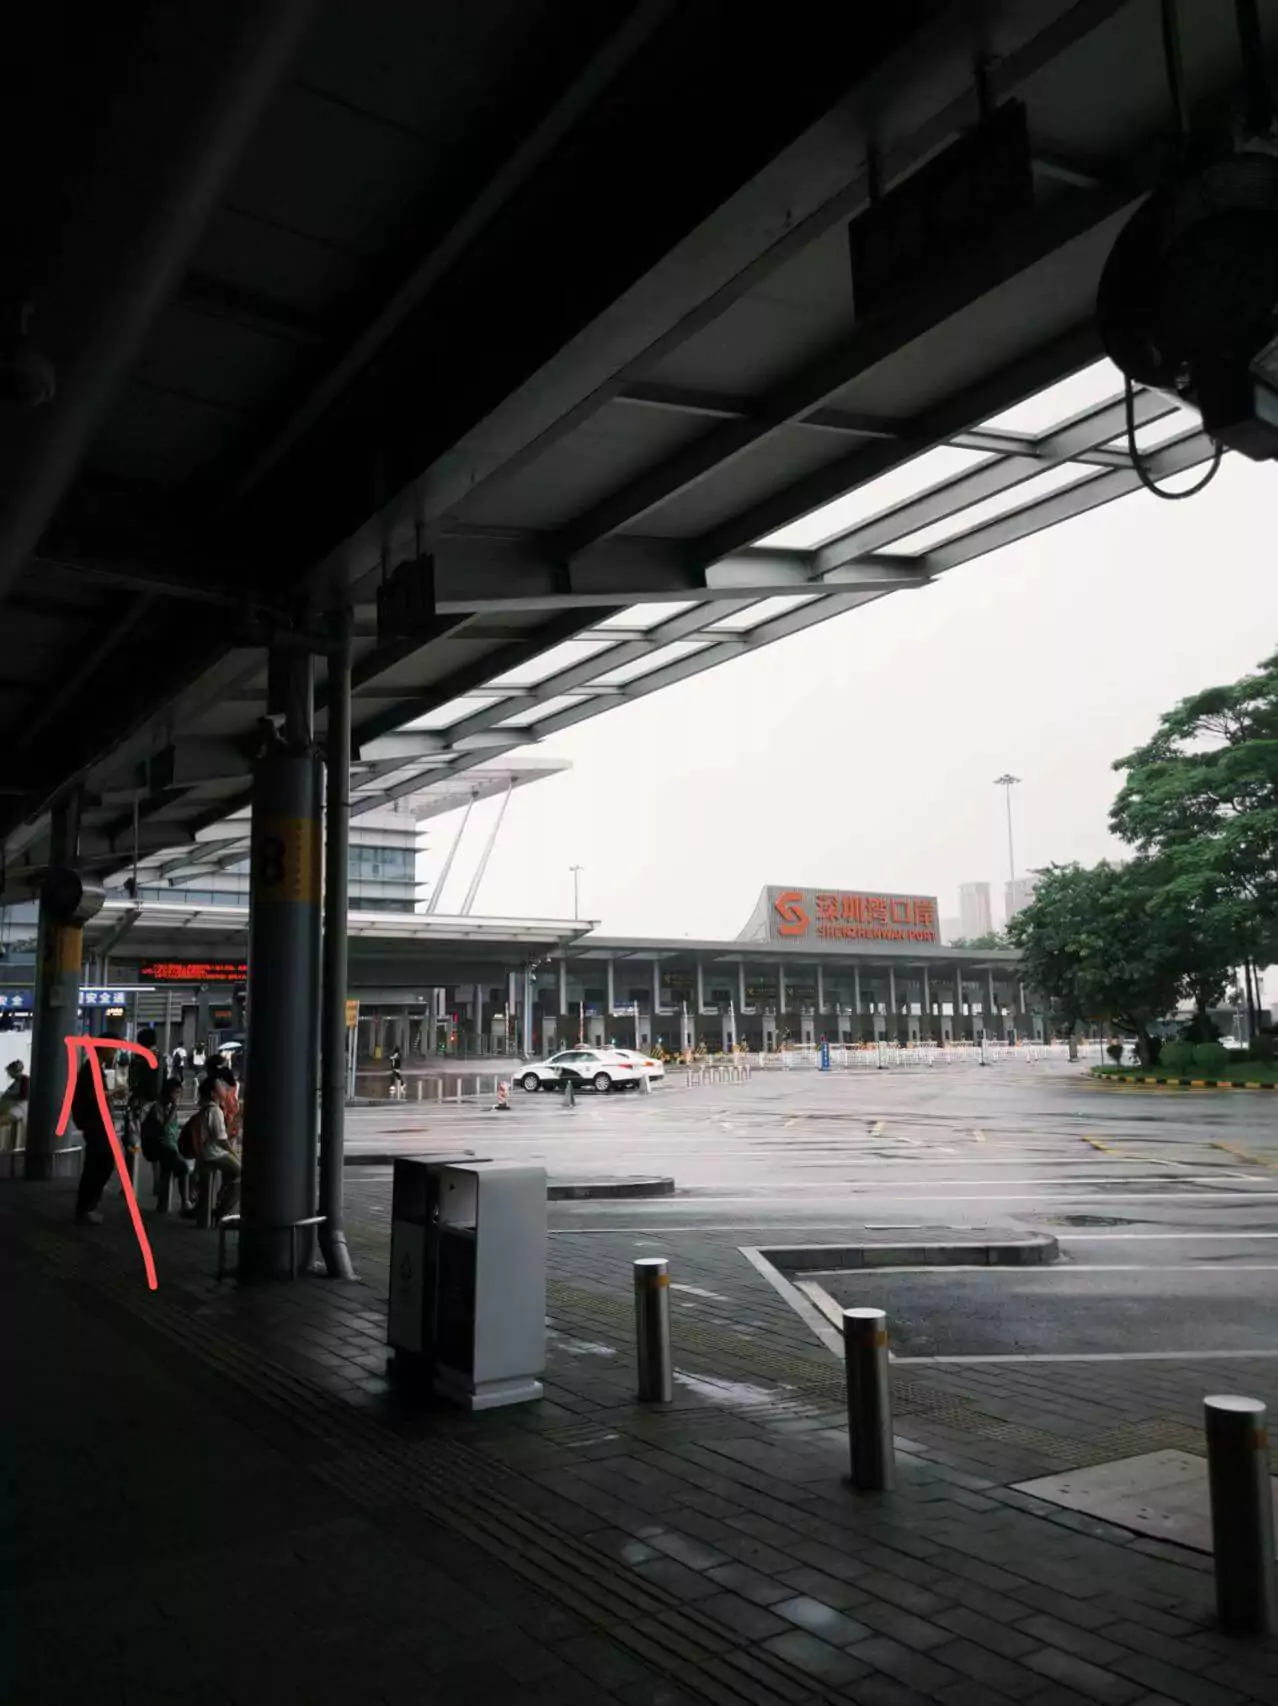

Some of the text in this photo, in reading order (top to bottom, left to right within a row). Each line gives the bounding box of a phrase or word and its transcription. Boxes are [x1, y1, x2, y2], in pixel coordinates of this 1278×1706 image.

[815, 894, 934, 927] 深圳湾口岸
[816, 925, 936, 942] SHENZHENWAN PORT
